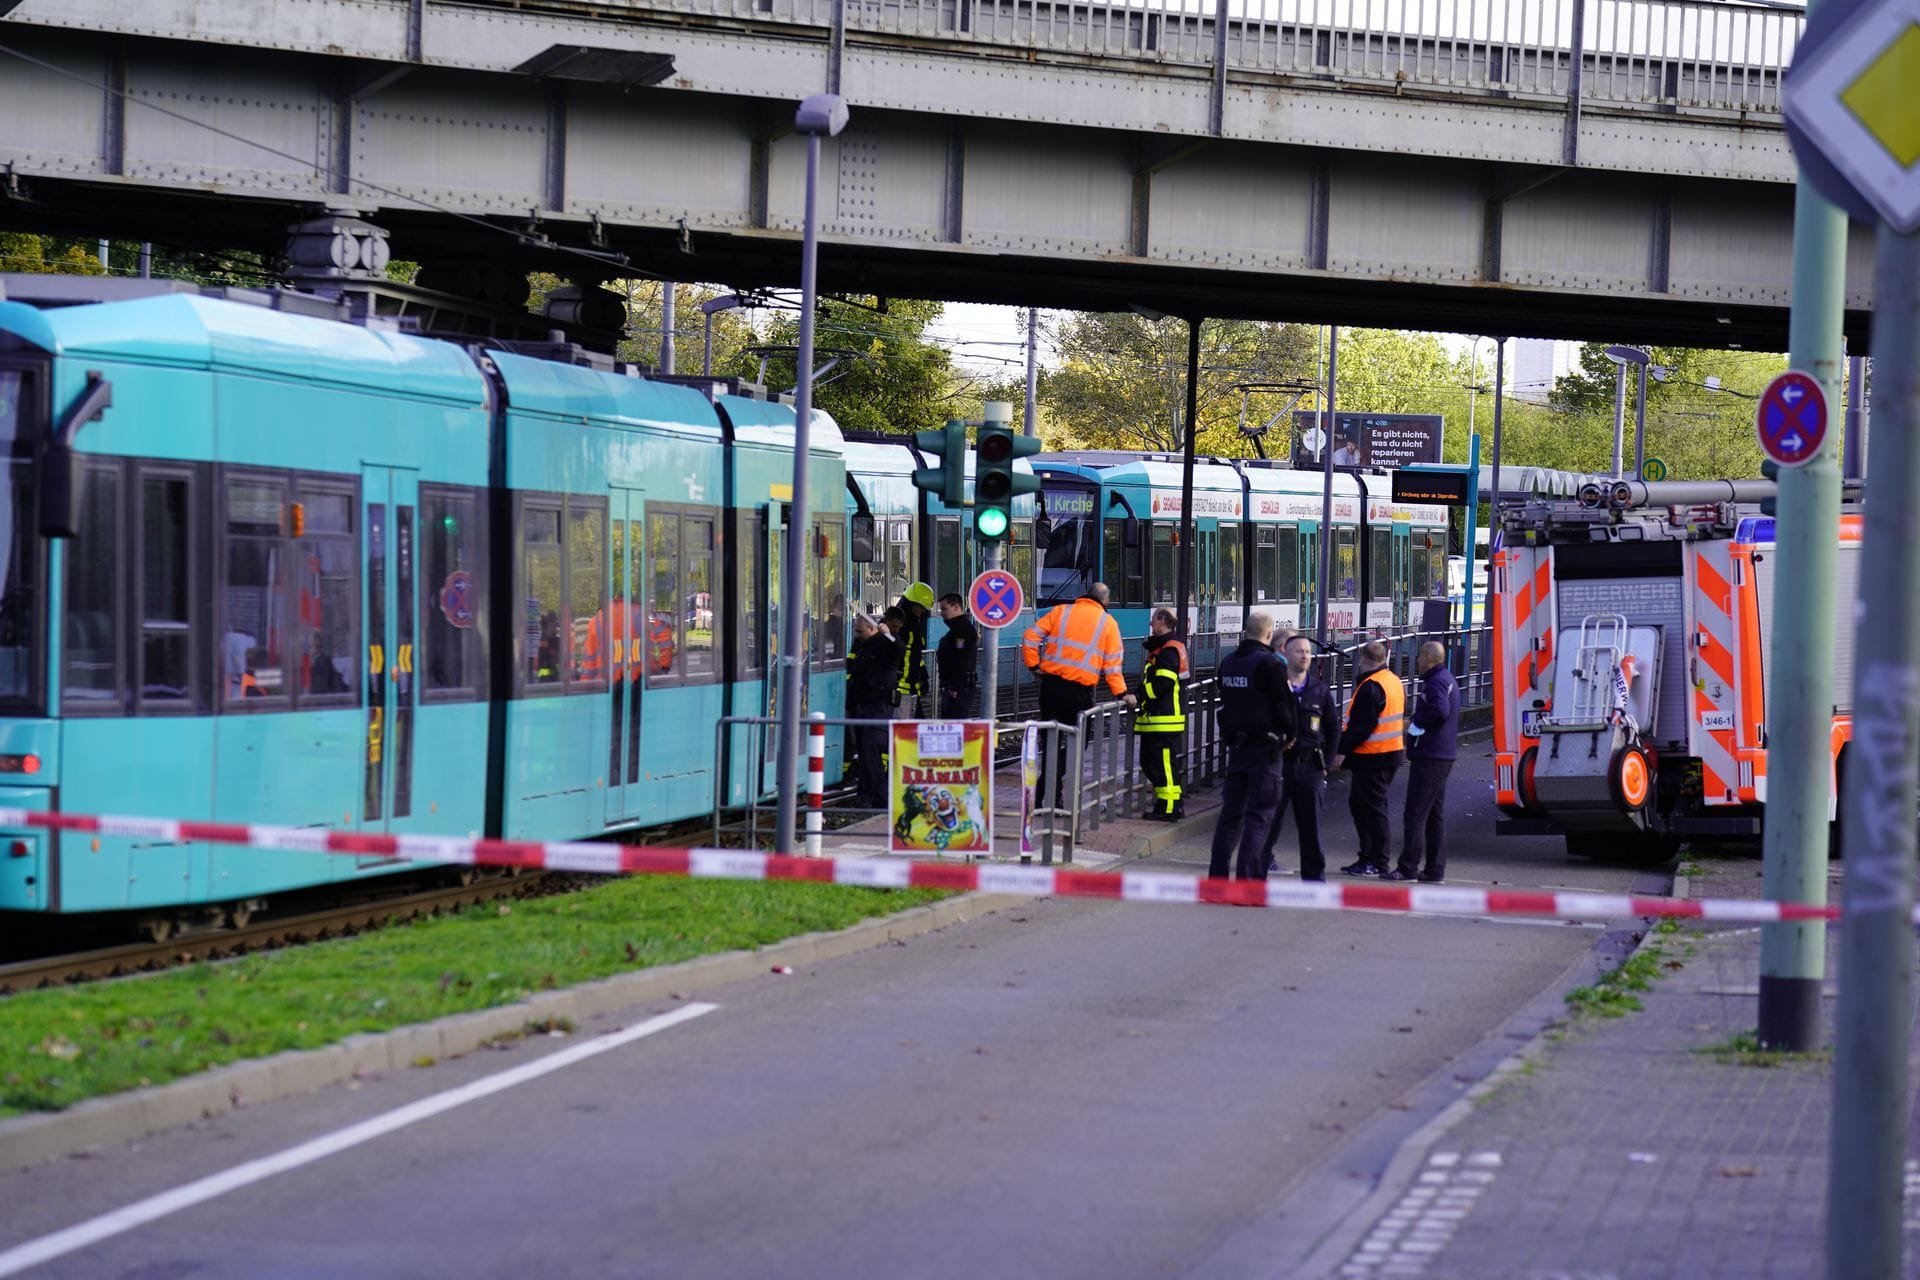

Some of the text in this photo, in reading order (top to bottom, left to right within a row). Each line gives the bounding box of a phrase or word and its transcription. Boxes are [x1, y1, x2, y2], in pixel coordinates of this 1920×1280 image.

[1371, 429, 1430, 441] Es gibt nichts,
[1389, 440, 1400, 448] du
[1401, 440, 1423, 448] nicht
[1371, 449, 1414, 459] reparieren
[1371, 458, 1401, 466] kannst.
[1647, 464, 1659, 479] H
[1054, 495, 1093, 512] Kirche
[1563, 584, 1677, 602] FEUERWEHR
[1563, 601, 1648, 616] FRANKFURT
[1222, 676, 1248, 688] POLIZEI
[1705, 717, 1730, 726] 3/46-1
